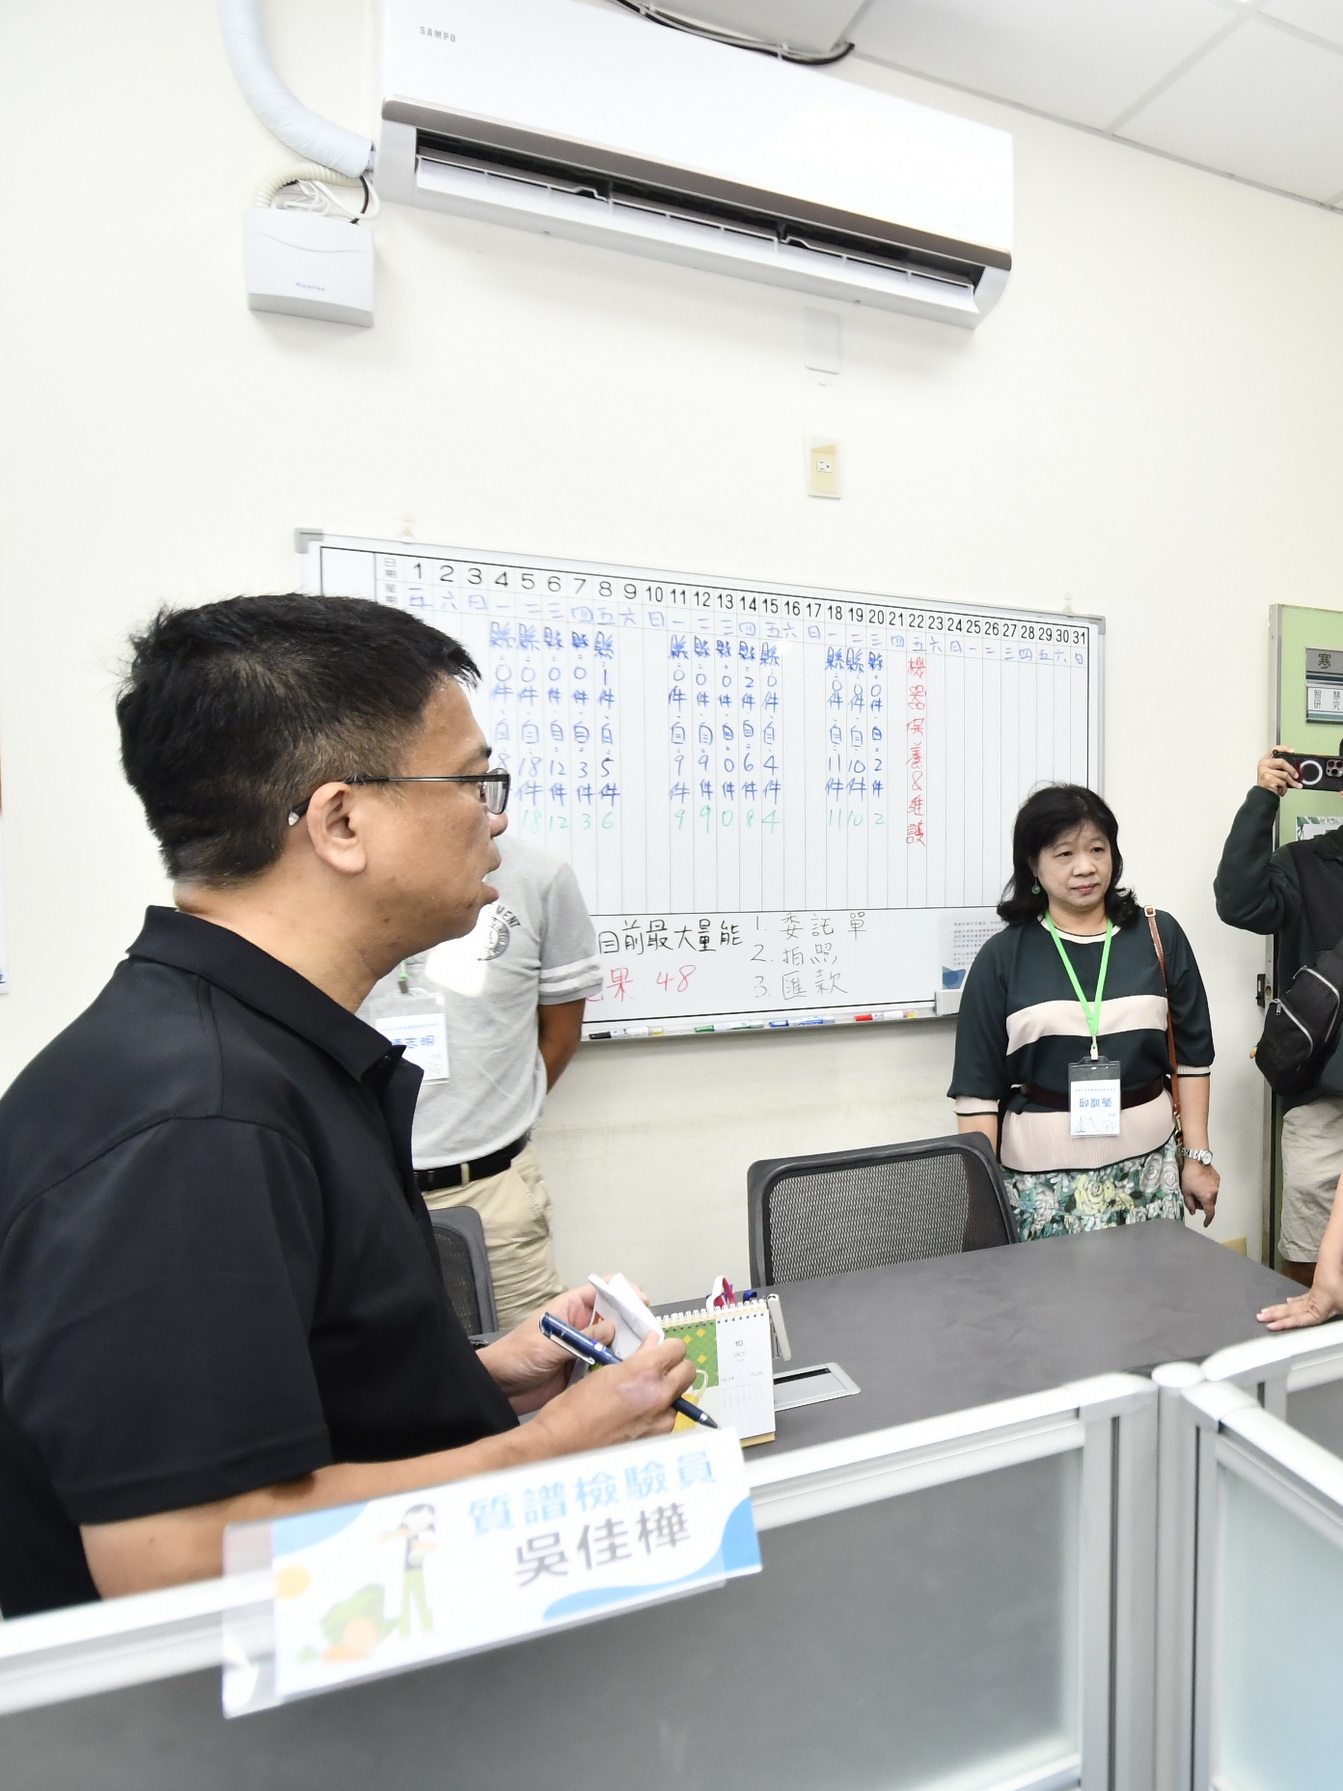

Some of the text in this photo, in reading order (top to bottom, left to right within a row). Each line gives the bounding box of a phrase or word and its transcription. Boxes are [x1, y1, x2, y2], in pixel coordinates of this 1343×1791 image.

[420, 26, 456, 42] SAMPO
[414, 563, 1085, 644] 1 2 3 4 5 6 7 8 9 10 11 12 13 14 15 16 17 18 19 20 21 22 23 24 25 26 27 28 29 30 31
[1318, 653, 1331, 669] 寒
[781, 911, 867, 940] 委託單
[783, 943, 838, 965] 拍照
[656, 965, 697, 992] 48
[782, 969, 848, 1000] 匯款
[467, 1450, 717, 1538] 質譜檢驗員
[515, 1502, 692, 1588] 吳佳樺
